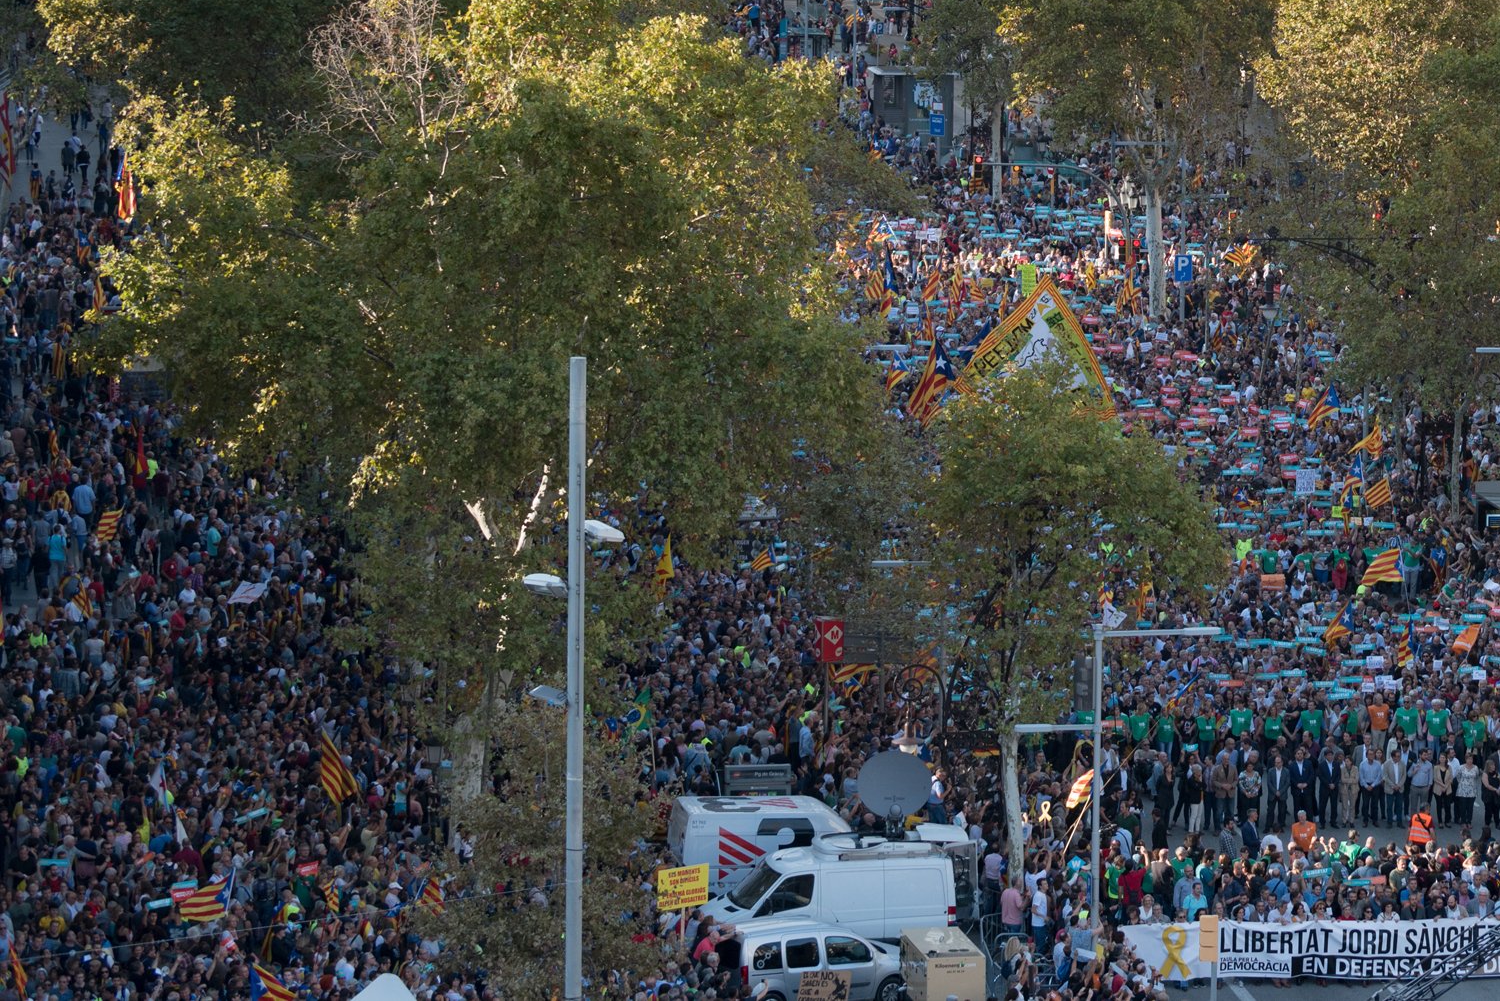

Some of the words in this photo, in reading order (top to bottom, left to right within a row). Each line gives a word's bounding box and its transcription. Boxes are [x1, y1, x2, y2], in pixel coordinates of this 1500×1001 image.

[1178, 256, 1190, 272] P
[830, 630, 840, 640] M
[1220, 927, 1334, 954] LLIBERTAT
[1338, 928, 1398, 954] JORDI
[1220, 960, 1290, 972] DEMOCRÀCIA
[1302, 957, 1328, 974] EN
[1335, 958, 1424, 976] DEFENSA
[820, 972, 834, 980] NO
